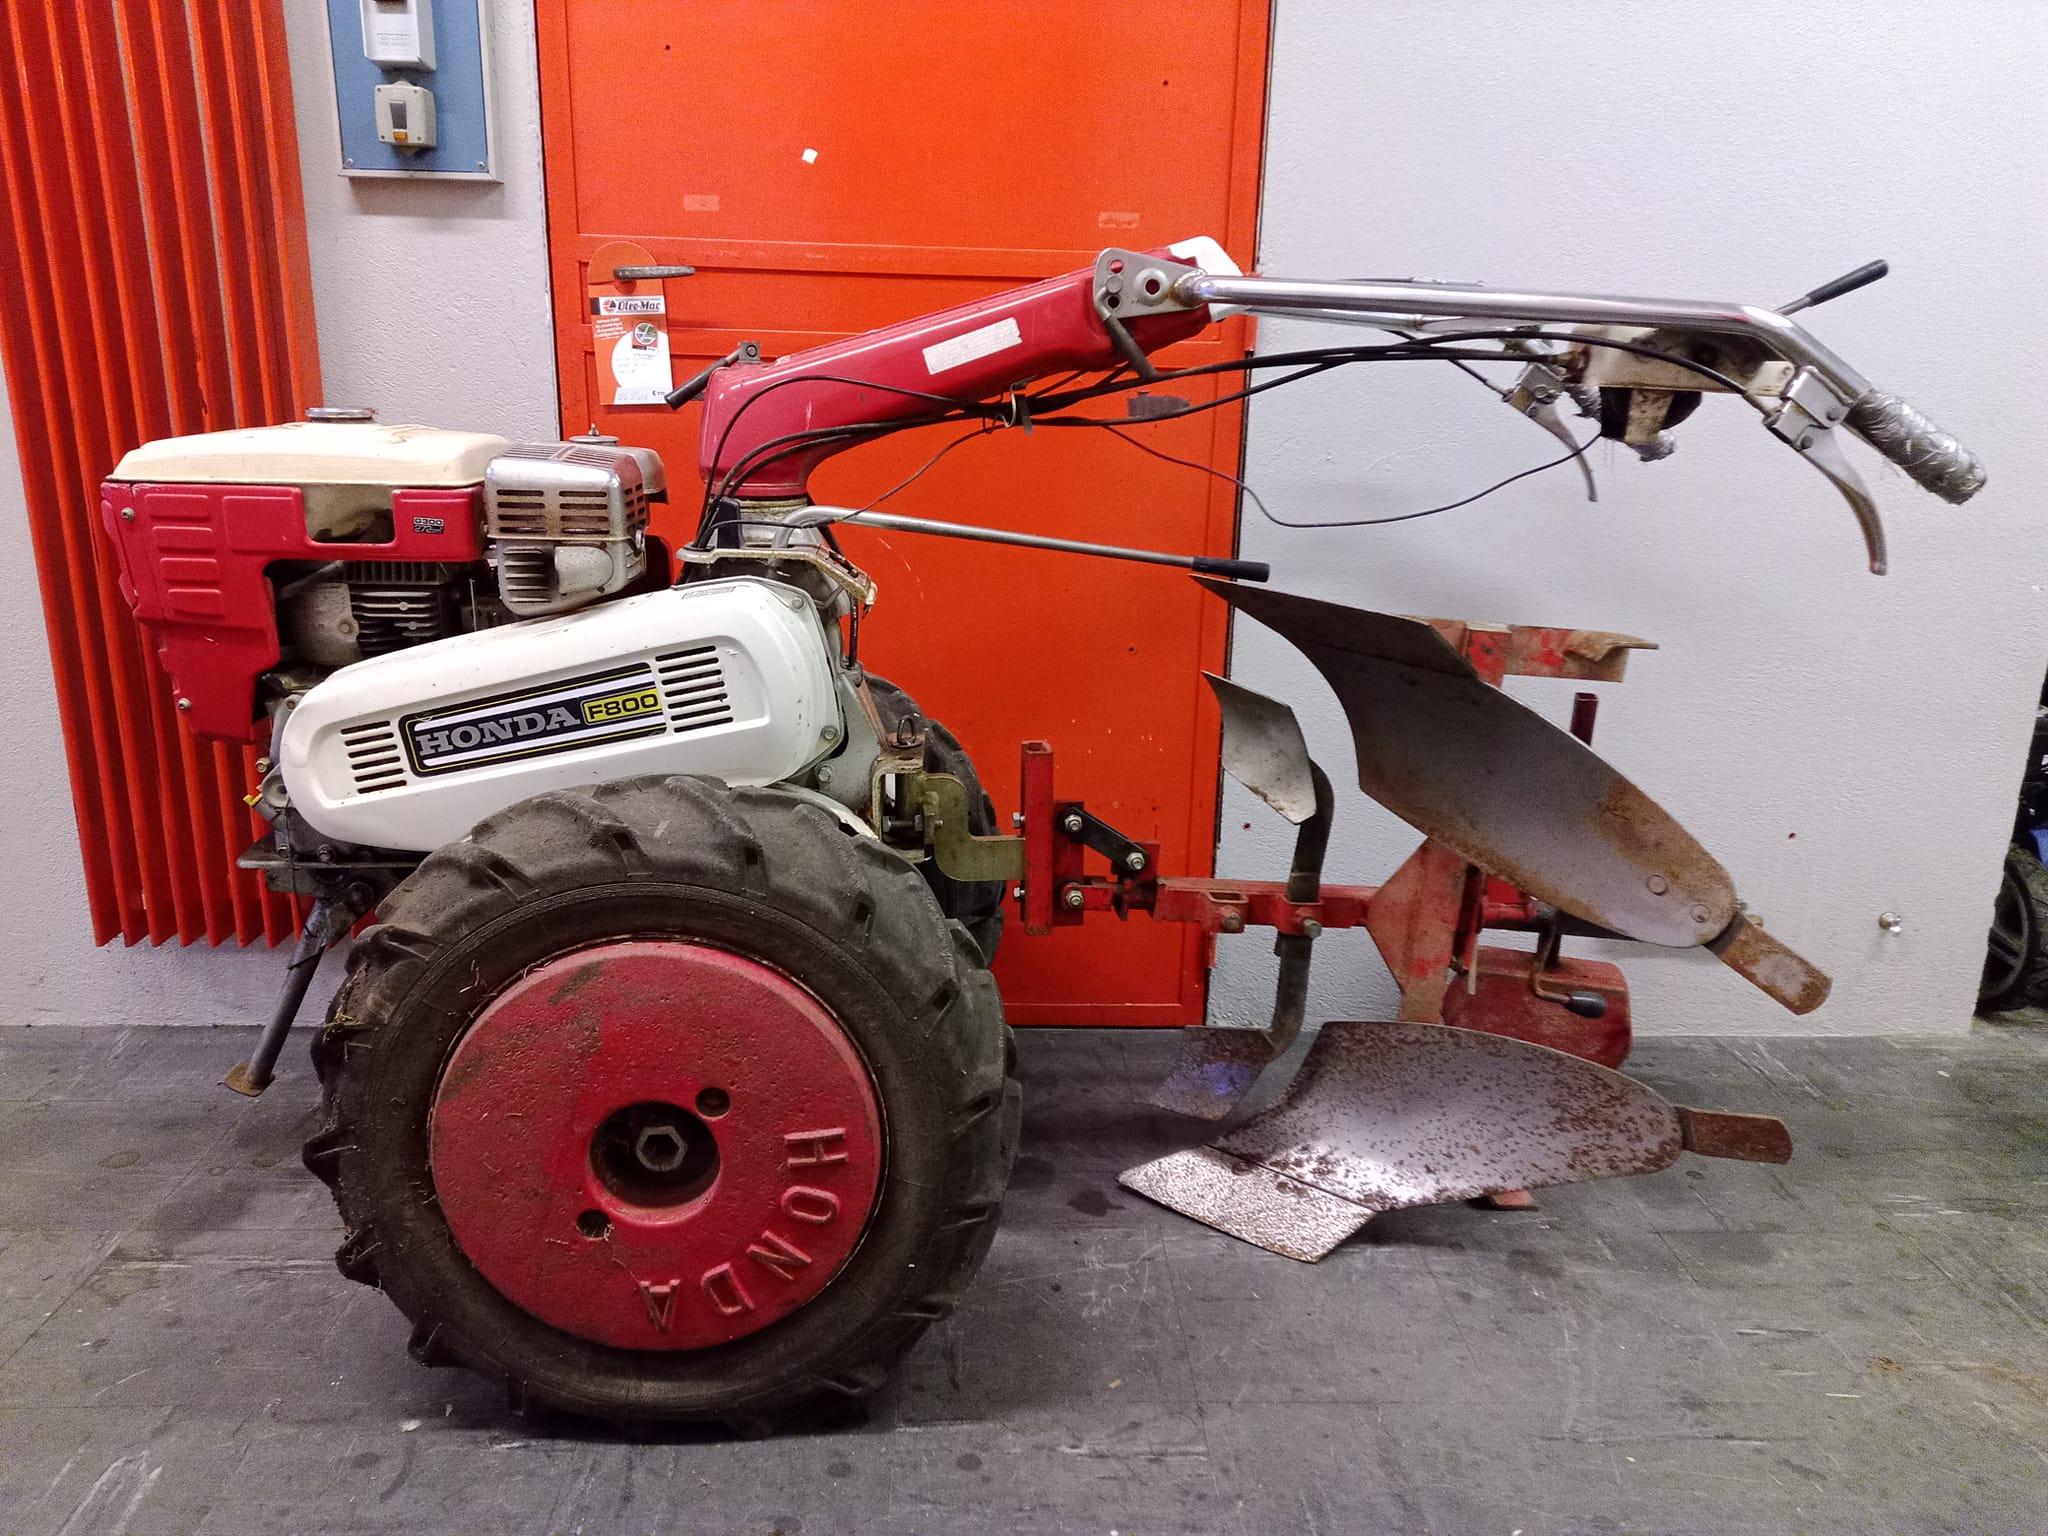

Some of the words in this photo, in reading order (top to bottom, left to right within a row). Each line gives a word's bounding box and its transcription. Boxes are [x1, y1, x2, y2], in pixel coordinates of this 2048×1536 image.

[617, 300, 661, 311] Oleo-Mac
[414, 706, 581, 757] HONDA
[588, 692, 659, 720] F800
[638, 1127, 849, 1331] HONDA
